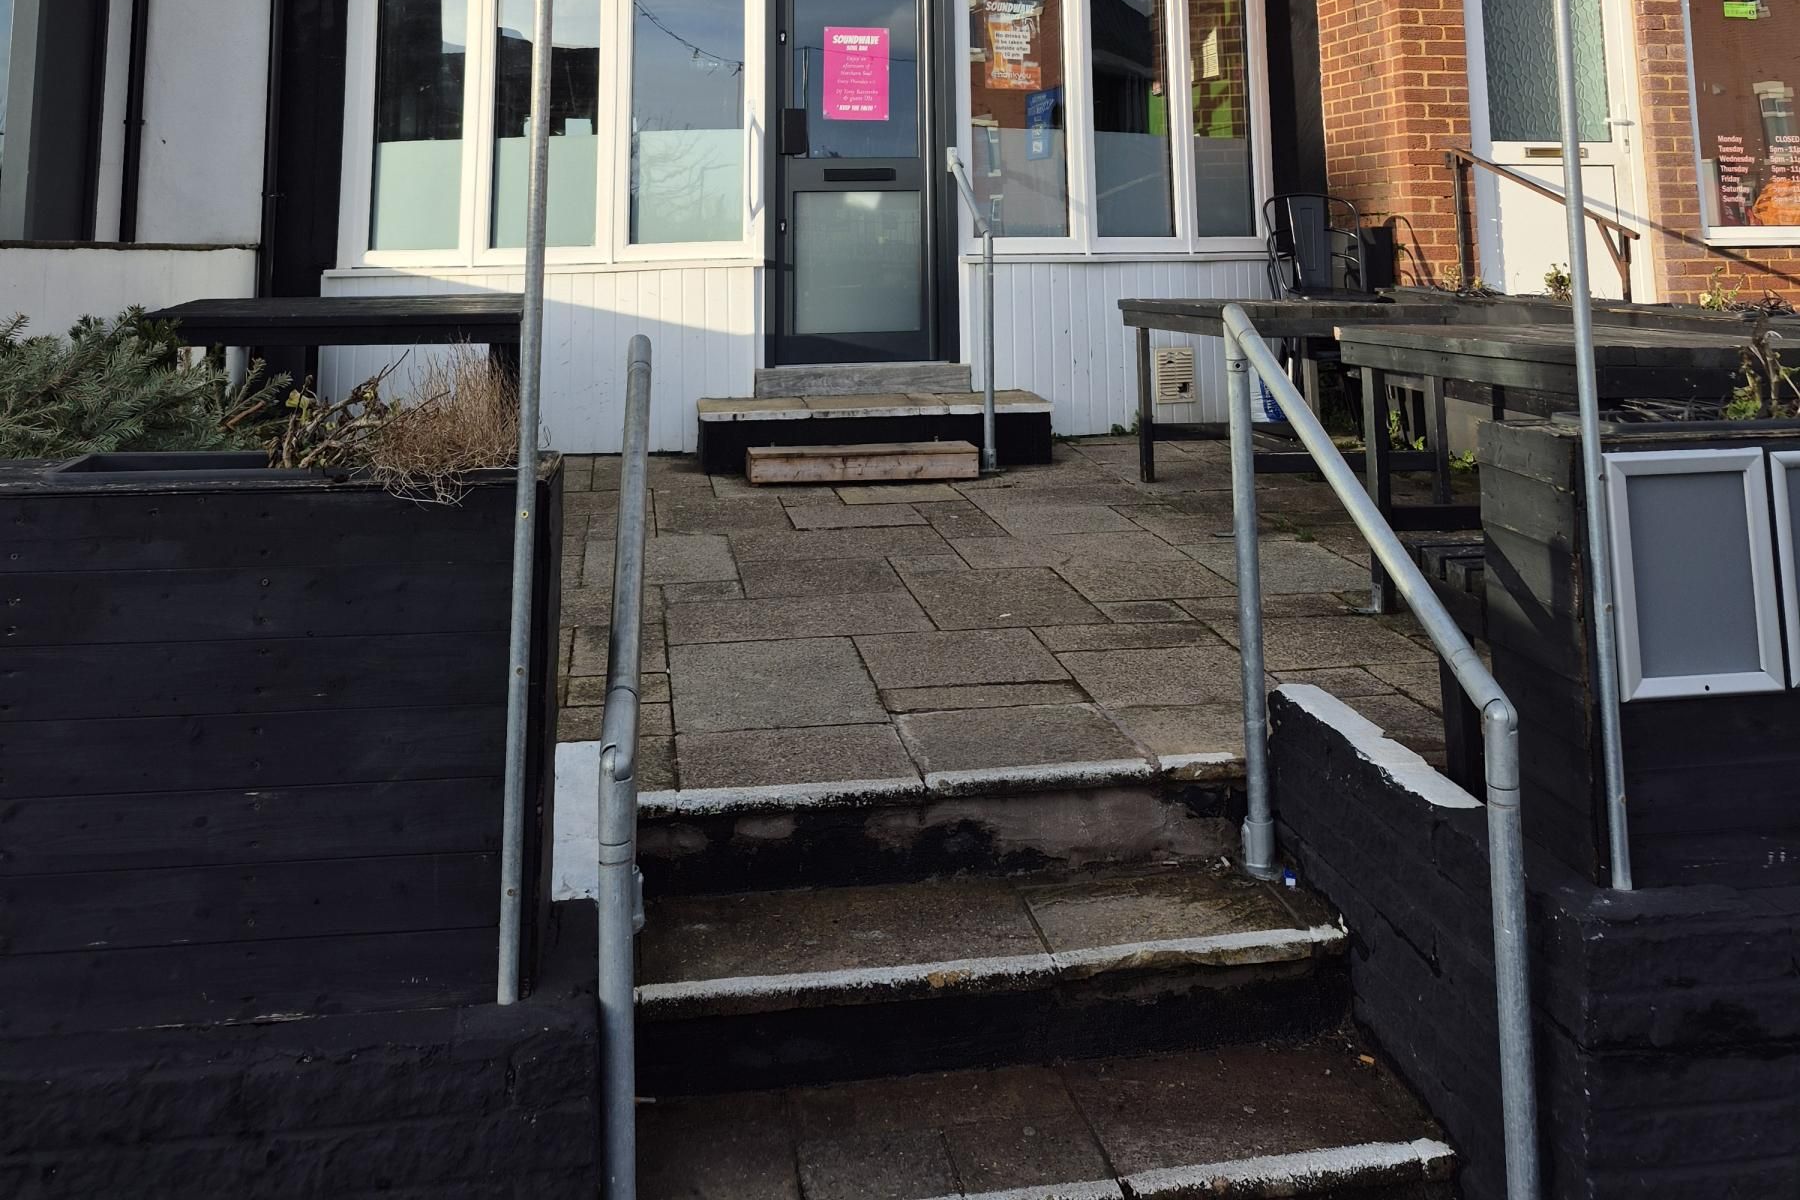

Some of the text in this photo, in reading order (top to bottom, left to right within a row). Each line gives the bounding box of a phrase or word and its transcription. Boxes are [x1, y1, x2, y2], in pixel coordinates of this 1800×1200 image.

[1717, 135, 1800, 144] Monday CLOSED
[1718, 145, 1744, 153] Tuesday
[1719, 155, 1755, 164] Wednesday
[1720, 165, 1749, 173] Thursday
[1721, 175, 1740, 183] Friday
[1722, 185, 1750, 193] Saturday
[1722, 195, 1746, 204] Sunday
